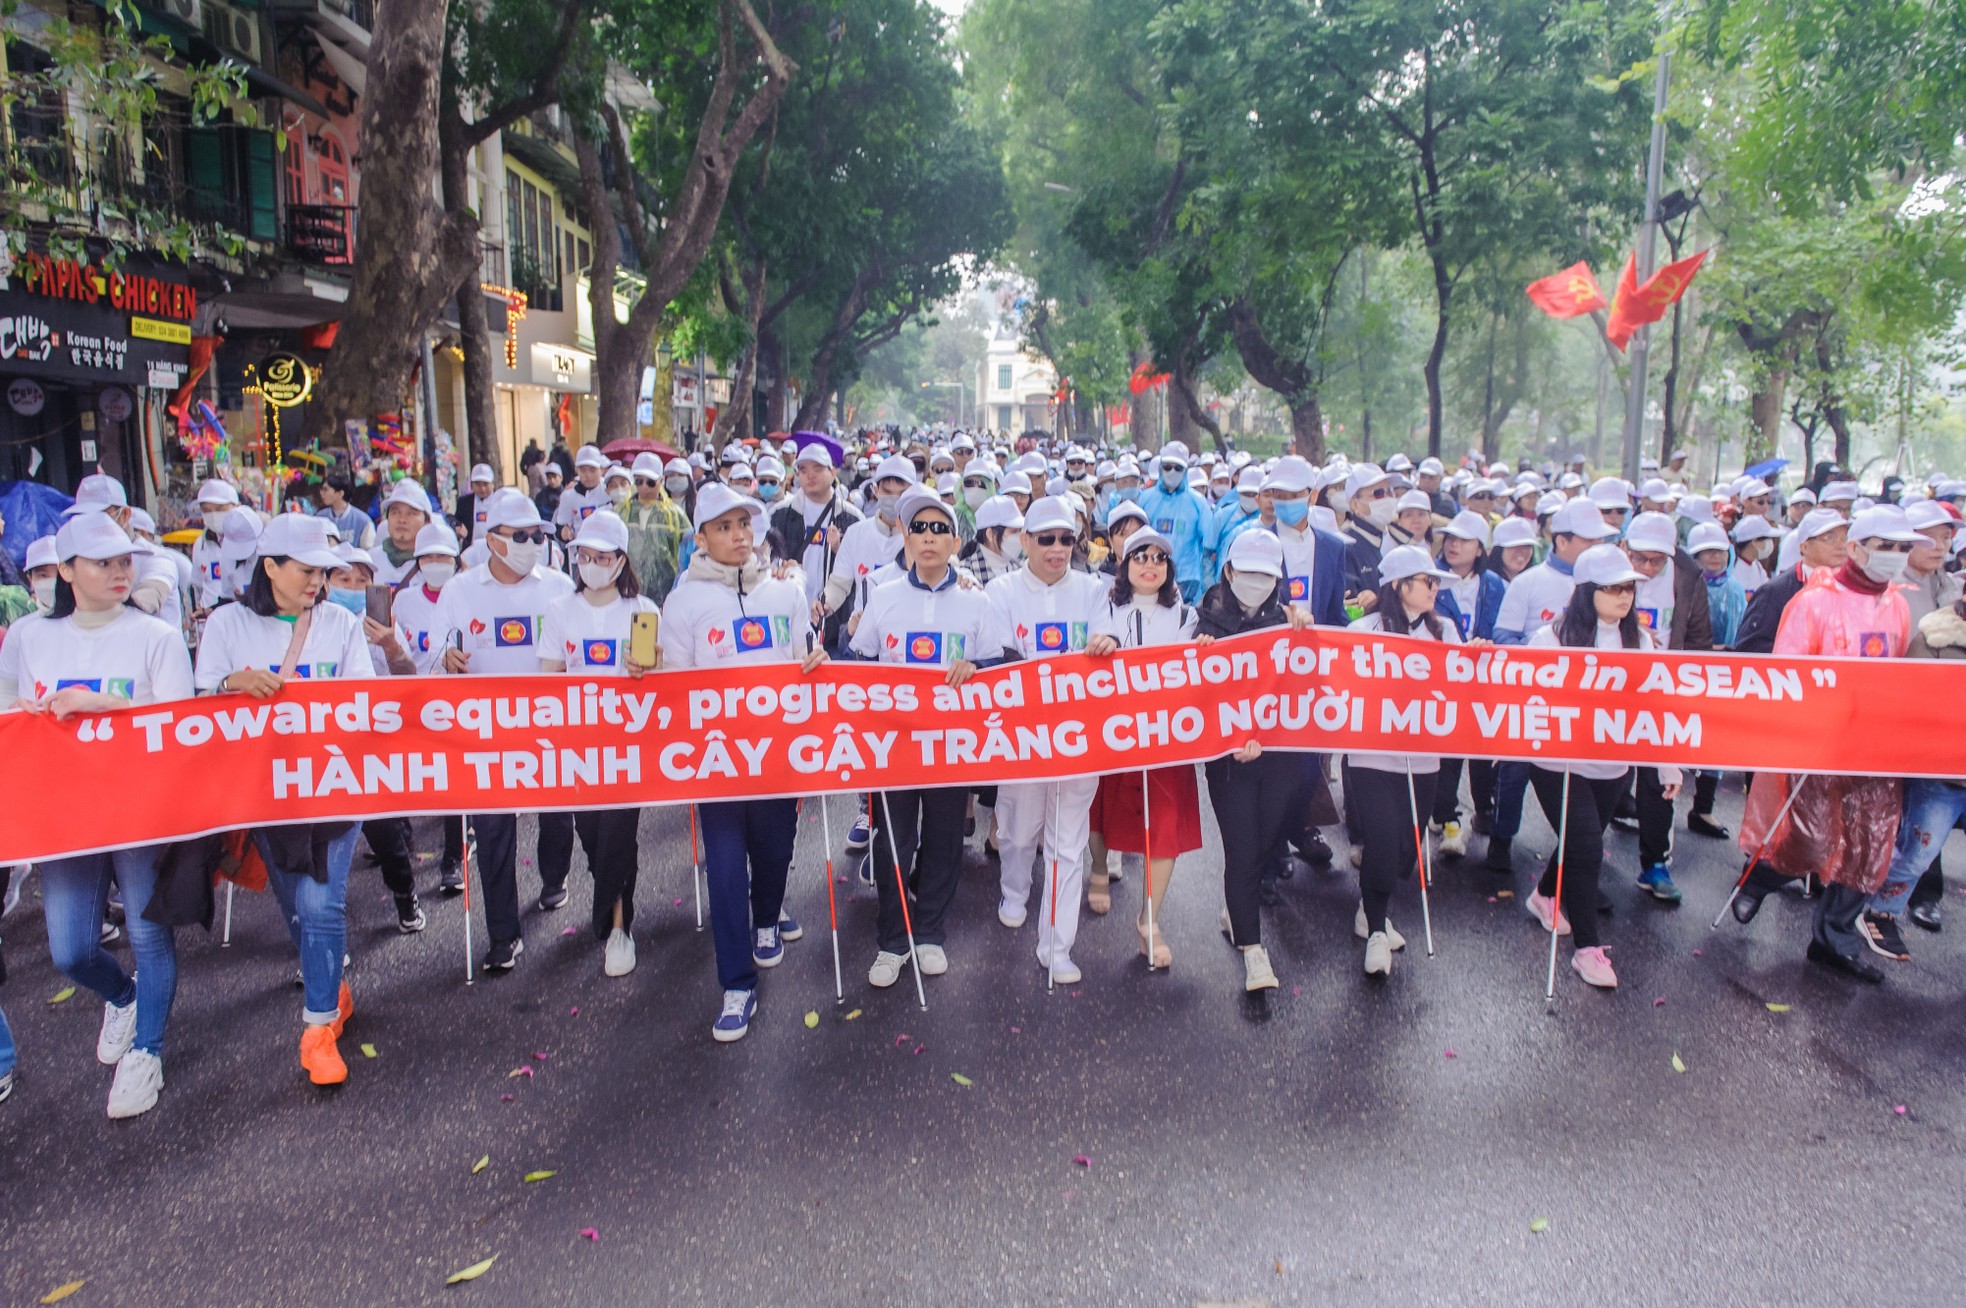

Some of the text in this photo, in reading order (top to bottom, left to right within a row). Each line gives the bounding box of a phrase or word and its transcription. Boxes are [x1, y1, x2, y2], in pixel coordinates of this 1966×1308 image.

[110, 271, 197, 320] CHICKEN
[67, 330, 101, 349] Korean
[104, 336, 127, 353] Food
[133, 691, 402, 753] Towards
[421, 683, 672, 739] equality,
[689, 682, 918, 730] progress
[933, 670, 1025, 711] and
[1038, 647, 1258, 705] inclusion
[1270, 638, 1347, 680] for
[1352, 643, 1431, 681] the
[1445, 649, 1570, 689] blind
[1579, 653, 1628, 691] in
[1638, 660, 1804, 702] ASEAN
[272, 685, 1703, 800] HÀNH TRÌNH CÂY GẬY TRẮNG CHO NGƯỜI MÙ VIỆT NAM
